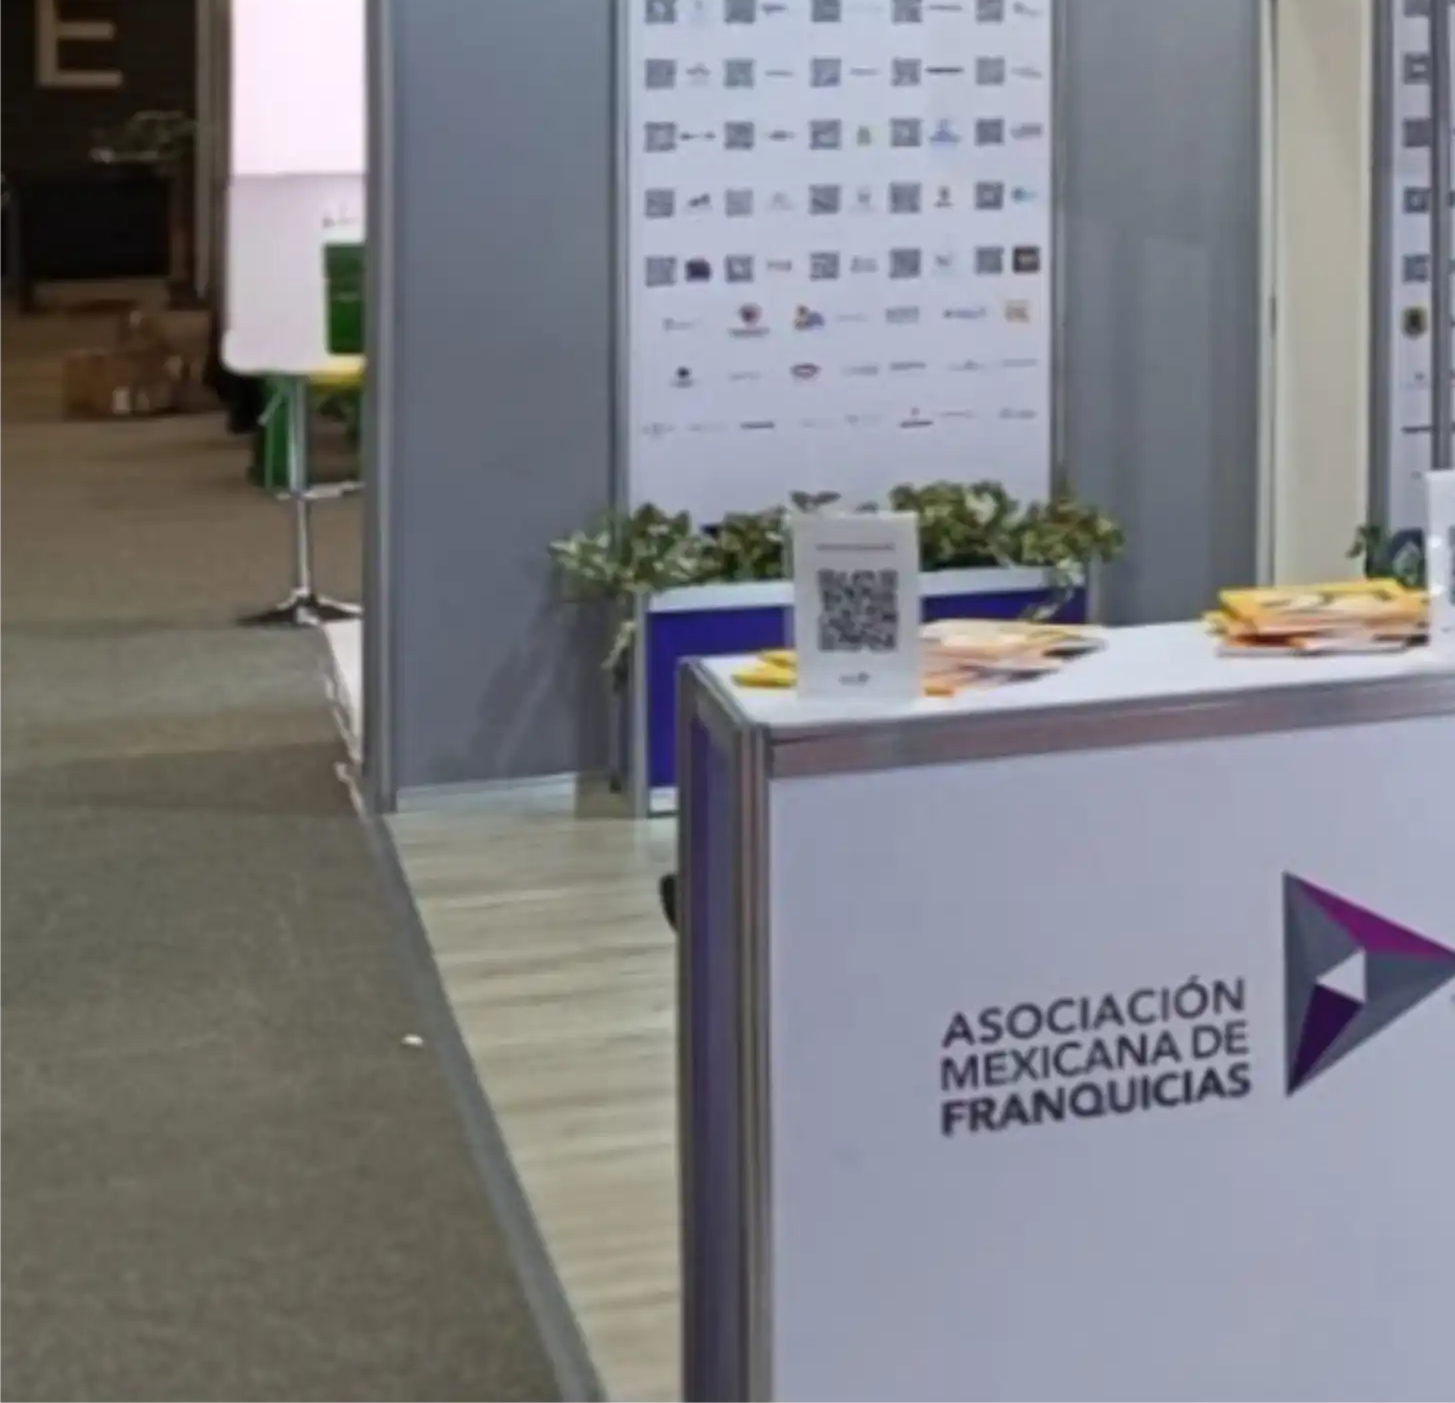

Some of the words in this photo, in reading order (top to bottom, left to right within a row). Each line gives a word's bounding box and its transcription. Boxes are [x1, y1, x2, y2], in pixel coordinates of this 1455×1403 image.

[941, 975, 1247, 1049] ASOCIACIÓN
[940, 1033, 1182, 1093] MEXICANA
[1191, 1020, 1250, 1059] DE
[940, 1062, 1252, 1138] FRANQUICIAS
